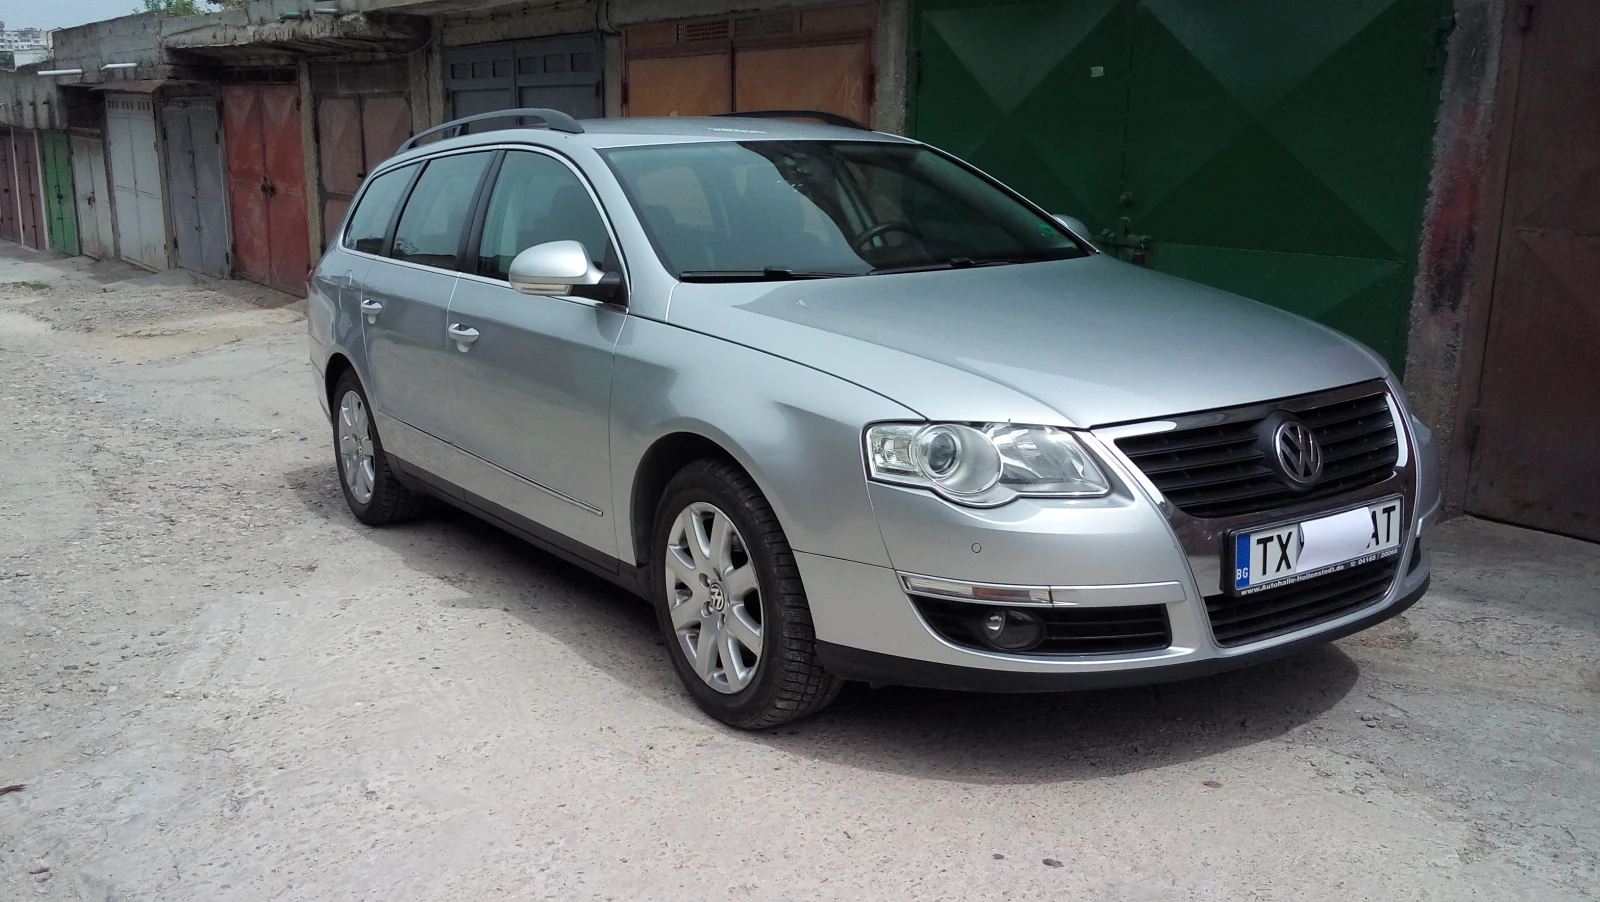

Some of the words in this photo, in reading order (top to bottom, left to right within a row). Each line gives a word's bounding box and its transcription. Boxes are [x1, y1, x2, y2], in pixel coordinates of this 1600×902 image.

[1277, 422, 1321, 482] VW
[1236, 567, 1249, 580] BG
[1256, 531, 1292, 576] TX
